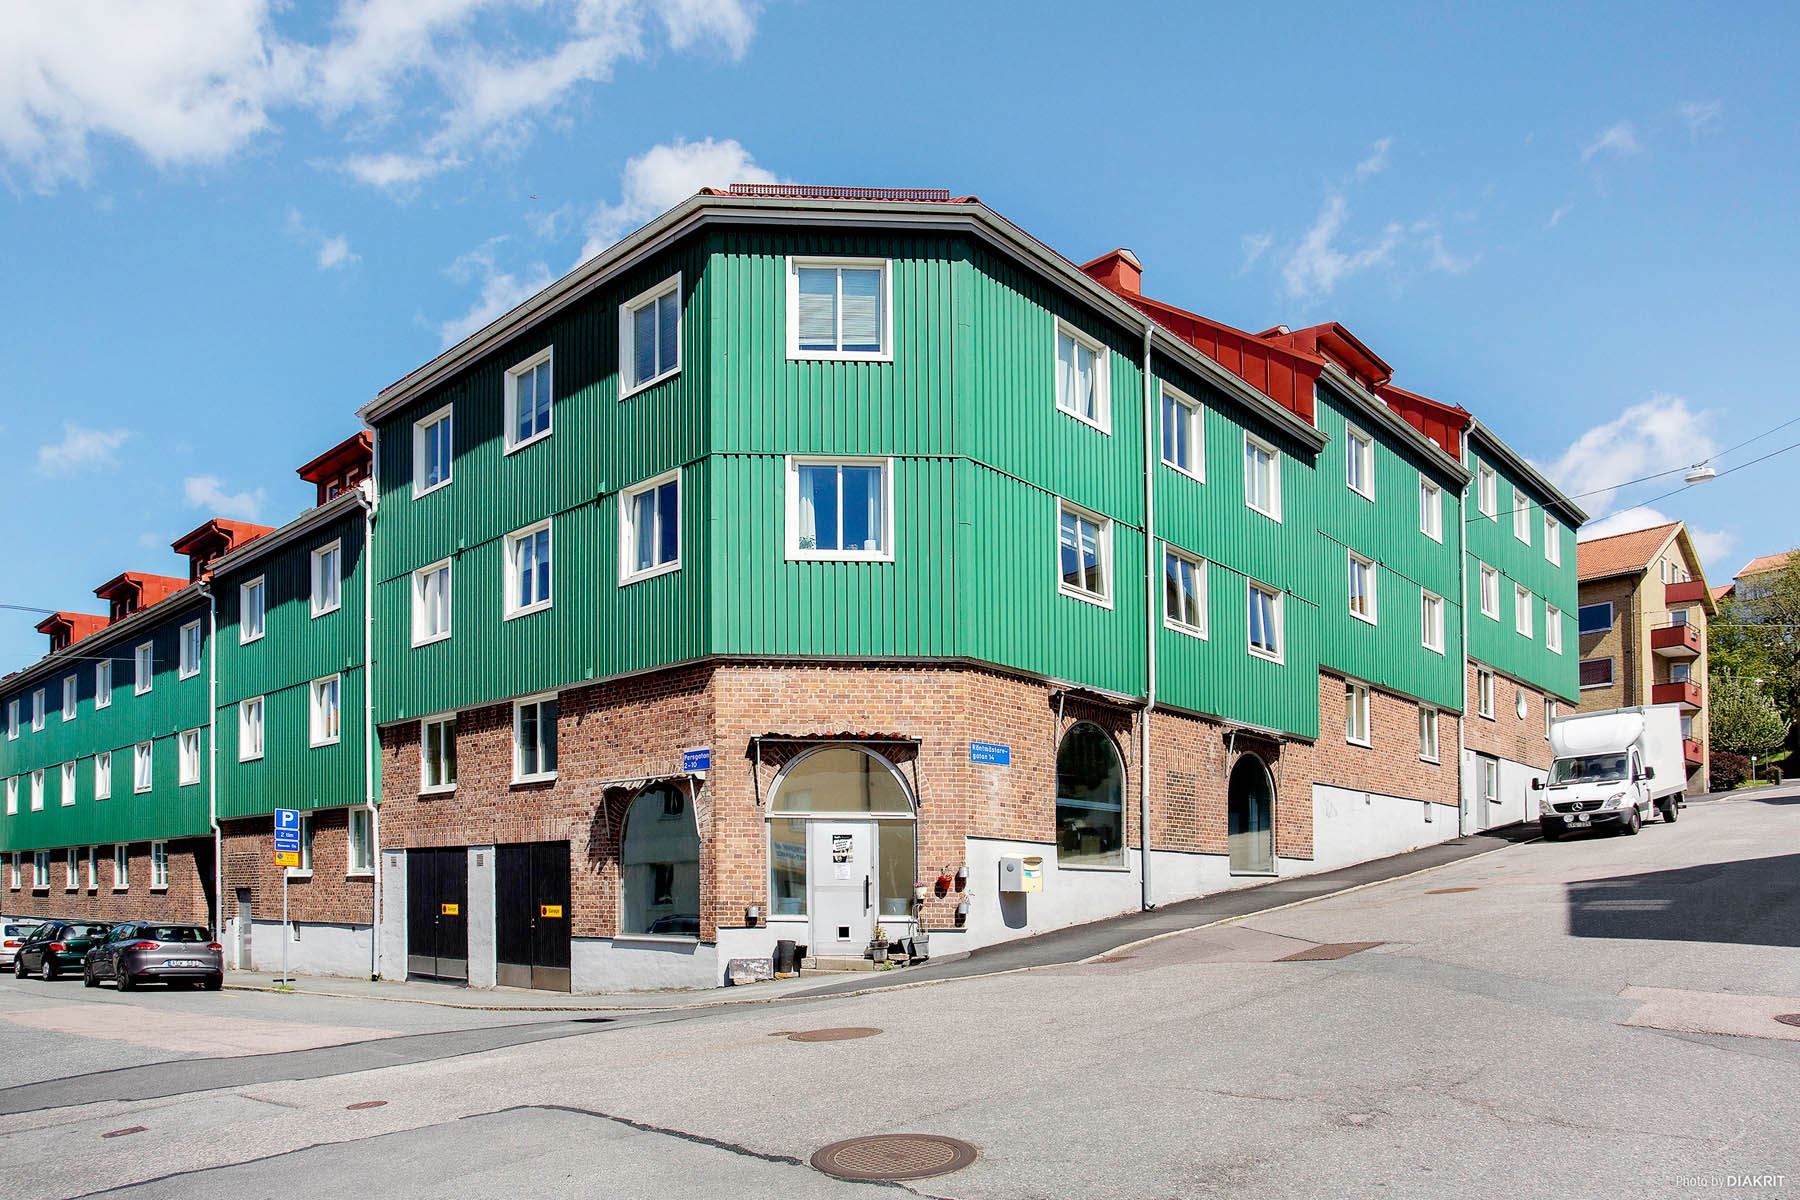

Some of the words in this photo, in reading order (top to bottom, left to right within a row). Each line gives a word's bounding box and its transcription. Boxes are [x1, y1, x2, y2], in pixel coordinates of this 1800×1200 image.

[684, 753, 709, 761] Persgatan
[973, 753, 988, 761] gatan
[282, 811, 294, 827] P
